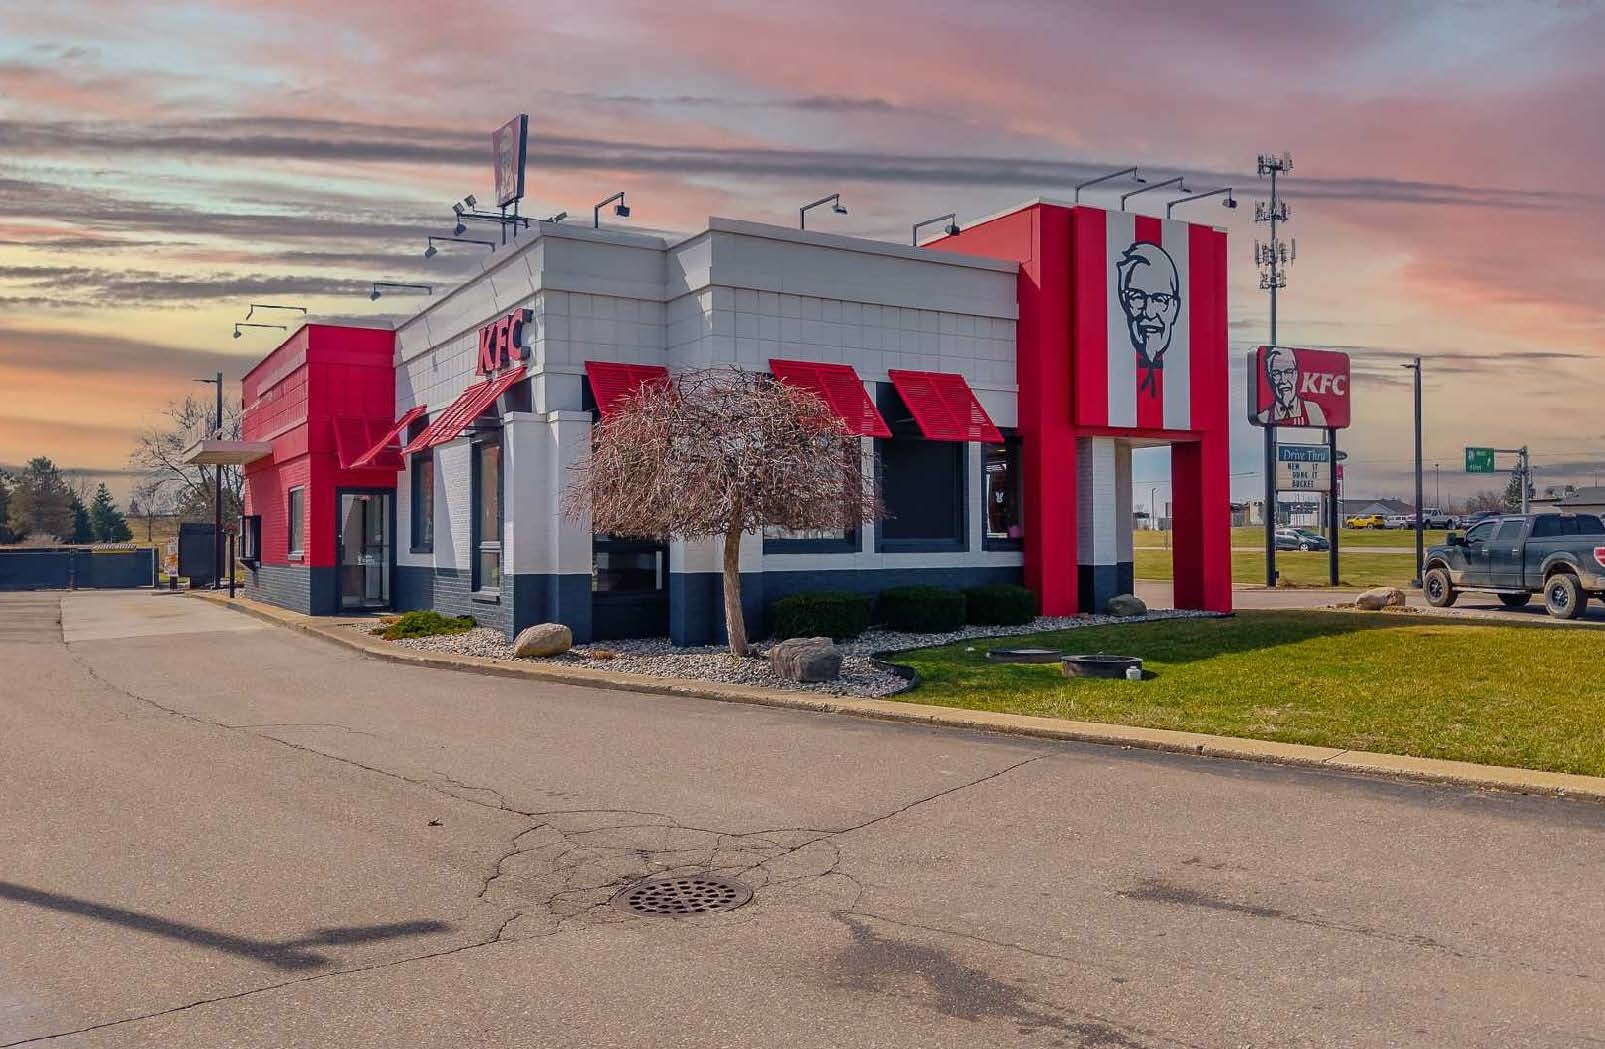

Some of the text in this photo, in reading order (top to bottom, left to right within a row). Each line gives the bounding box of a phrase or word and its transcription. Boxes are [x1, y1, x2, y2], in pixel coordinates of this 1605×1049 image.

[476, 307, 532, 376] KFC
[1300, 372, 1346, 396] KFC
[1284, 448, 1305, 460] Drive
[1292, 480, 1314, 488] BUCKET
